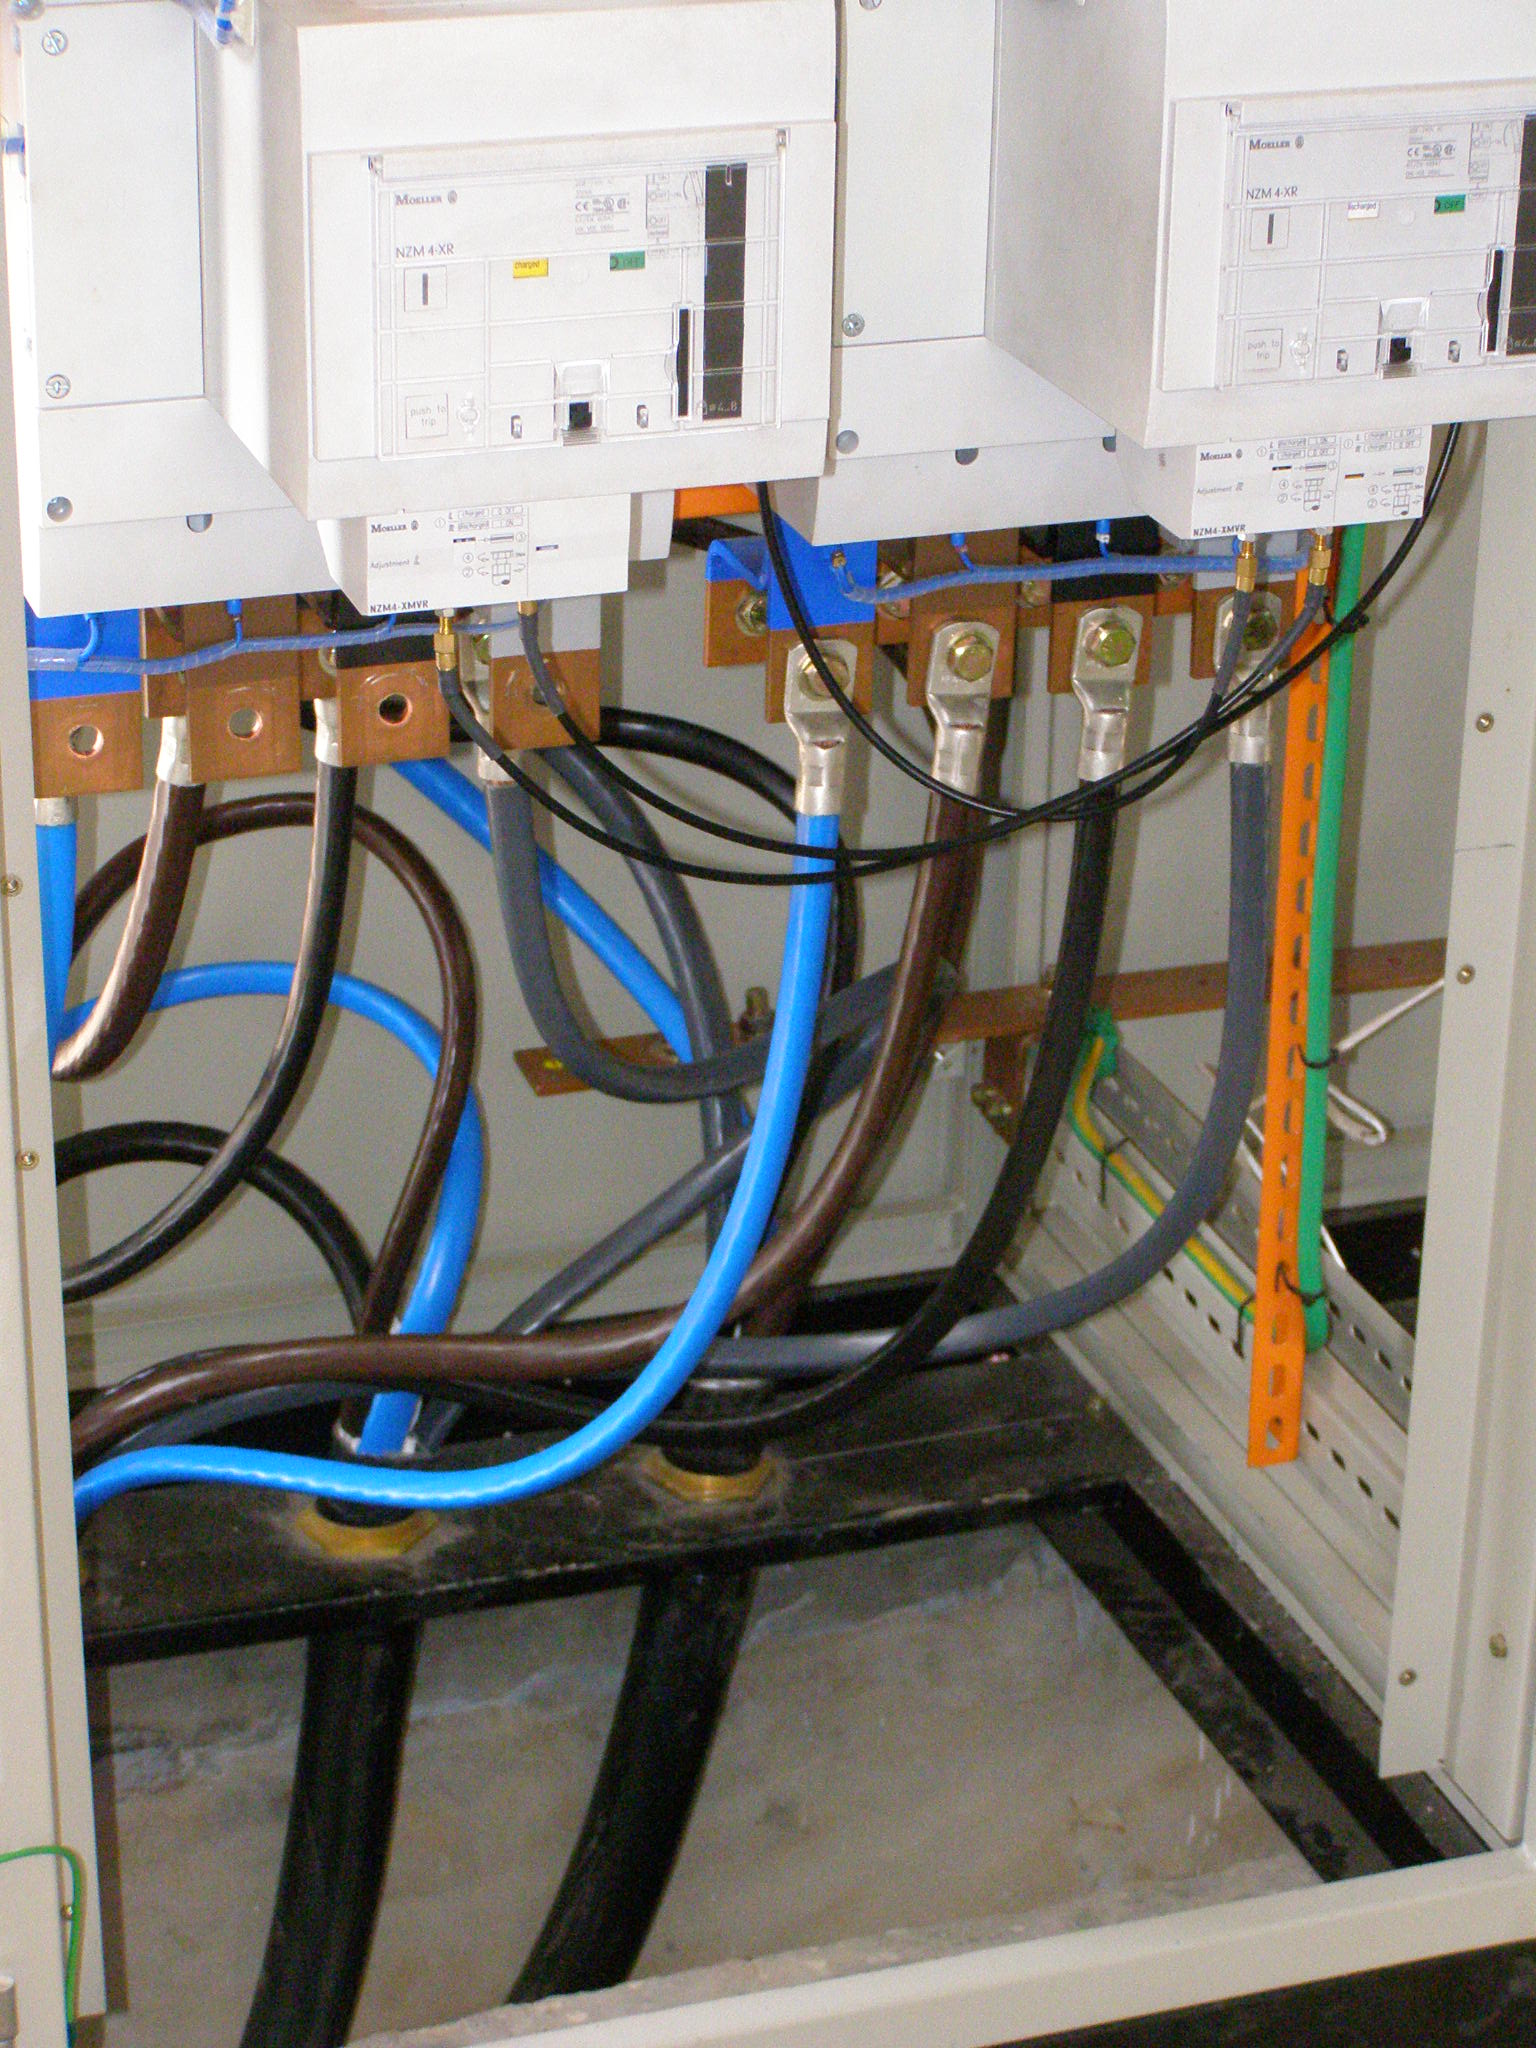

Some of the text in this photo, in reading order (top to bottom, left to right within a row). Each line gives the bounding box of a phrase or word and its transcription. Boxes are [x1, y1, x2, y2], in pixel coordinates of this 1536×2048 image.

[1246, 187, 1272, 200] NZM
[395, 244, 425, 259] NZM
[514, 260, 541, 270] charged
[1247, 339, 1280, 351] push to
[1256, 351, 1270, 360] trip
[410, 404, 447, 417] push to
[420, 417, 437, 428] trip
[1196, 485, 1233, 495] Adjustment
[370, 559, 410, 570] Adjustment
[369, 599, 429, 614] NZM4-XMVR
